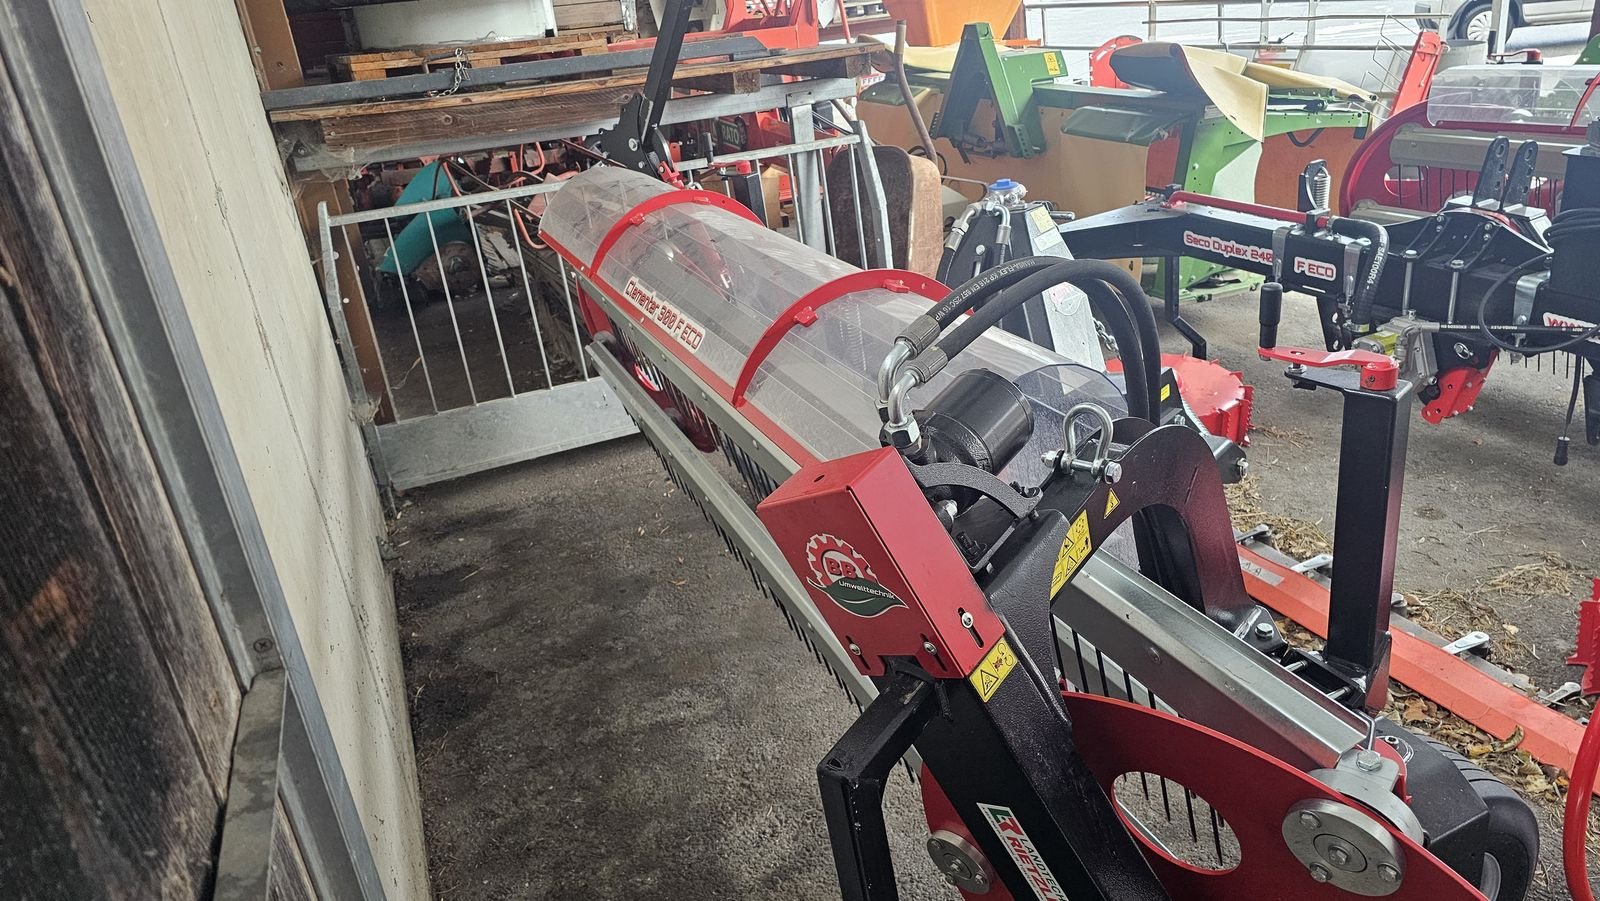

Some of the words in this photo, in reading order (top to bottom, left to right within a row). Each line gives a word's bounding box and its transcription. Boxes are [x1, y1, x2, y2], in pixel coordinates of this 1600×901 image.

[1185, 233, 1211, 249] Seco
[1212, 239, 1248, 257] Duplex
[1250, 249, 1274, 263] 240
[1296, 260, 1306, 272] F
[1308, 263, 1334, 279] ECO
[625, 280, 660, 315] Clementer
[656, 305, 678, 330] 300
[680, 322, 703, 350] ECO
[838, 580, 896, 600] Umwelttechnik
